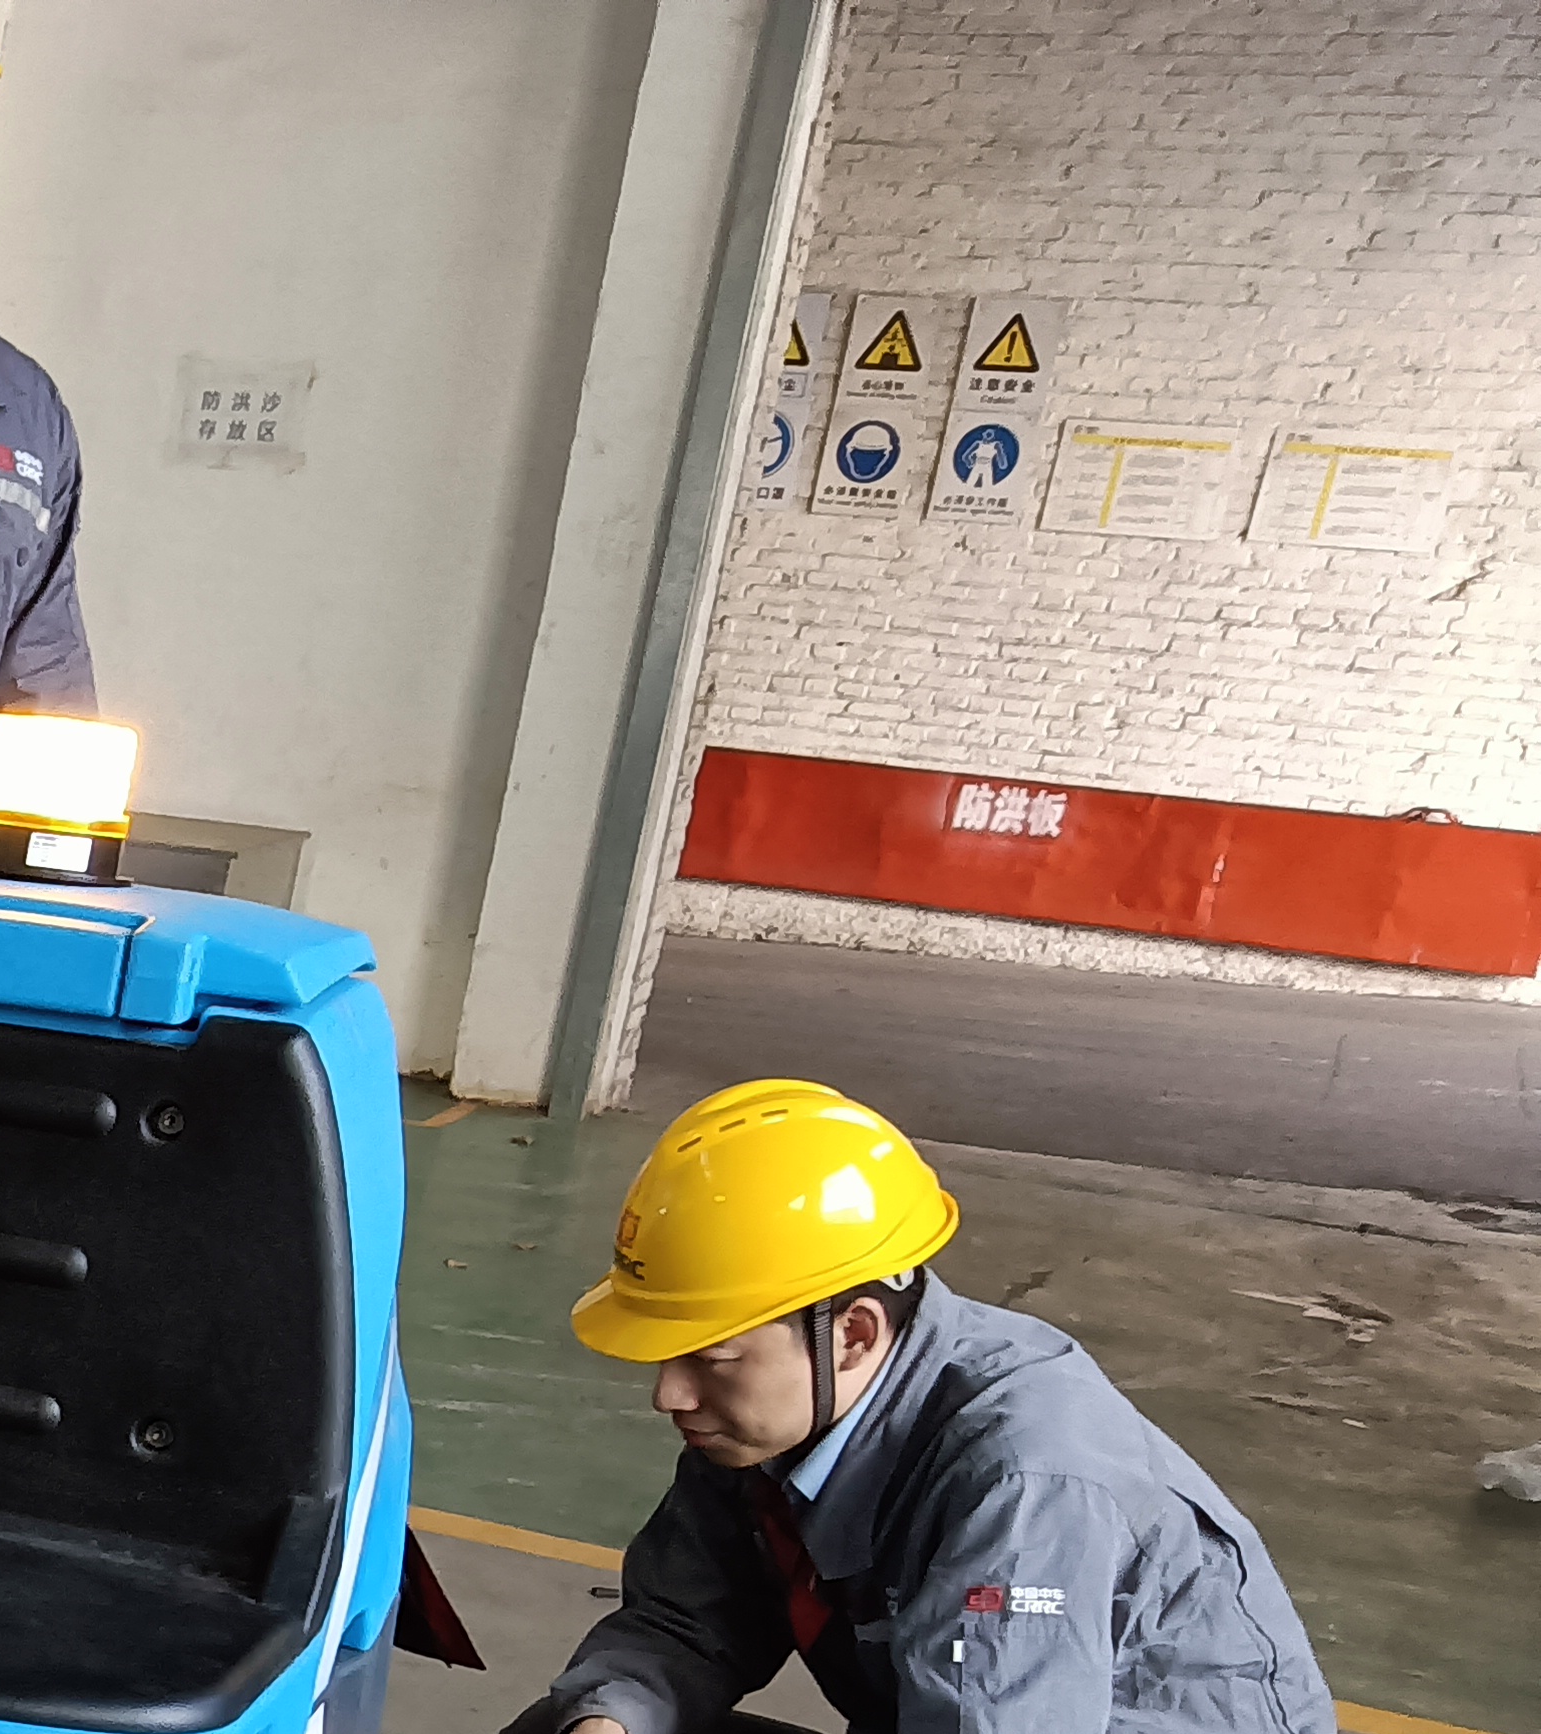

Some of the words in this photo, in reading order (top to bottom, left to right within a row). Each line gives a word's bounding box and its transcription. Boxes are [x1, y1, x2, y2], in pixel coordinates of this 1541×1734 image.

[201, 390, 281, 413] 防洪沙
[199, 419, 277, 442] 存放区
[952, 783, 1068, 838] 防洪板
[1011, 1600, 1065, 1615] CRRC
